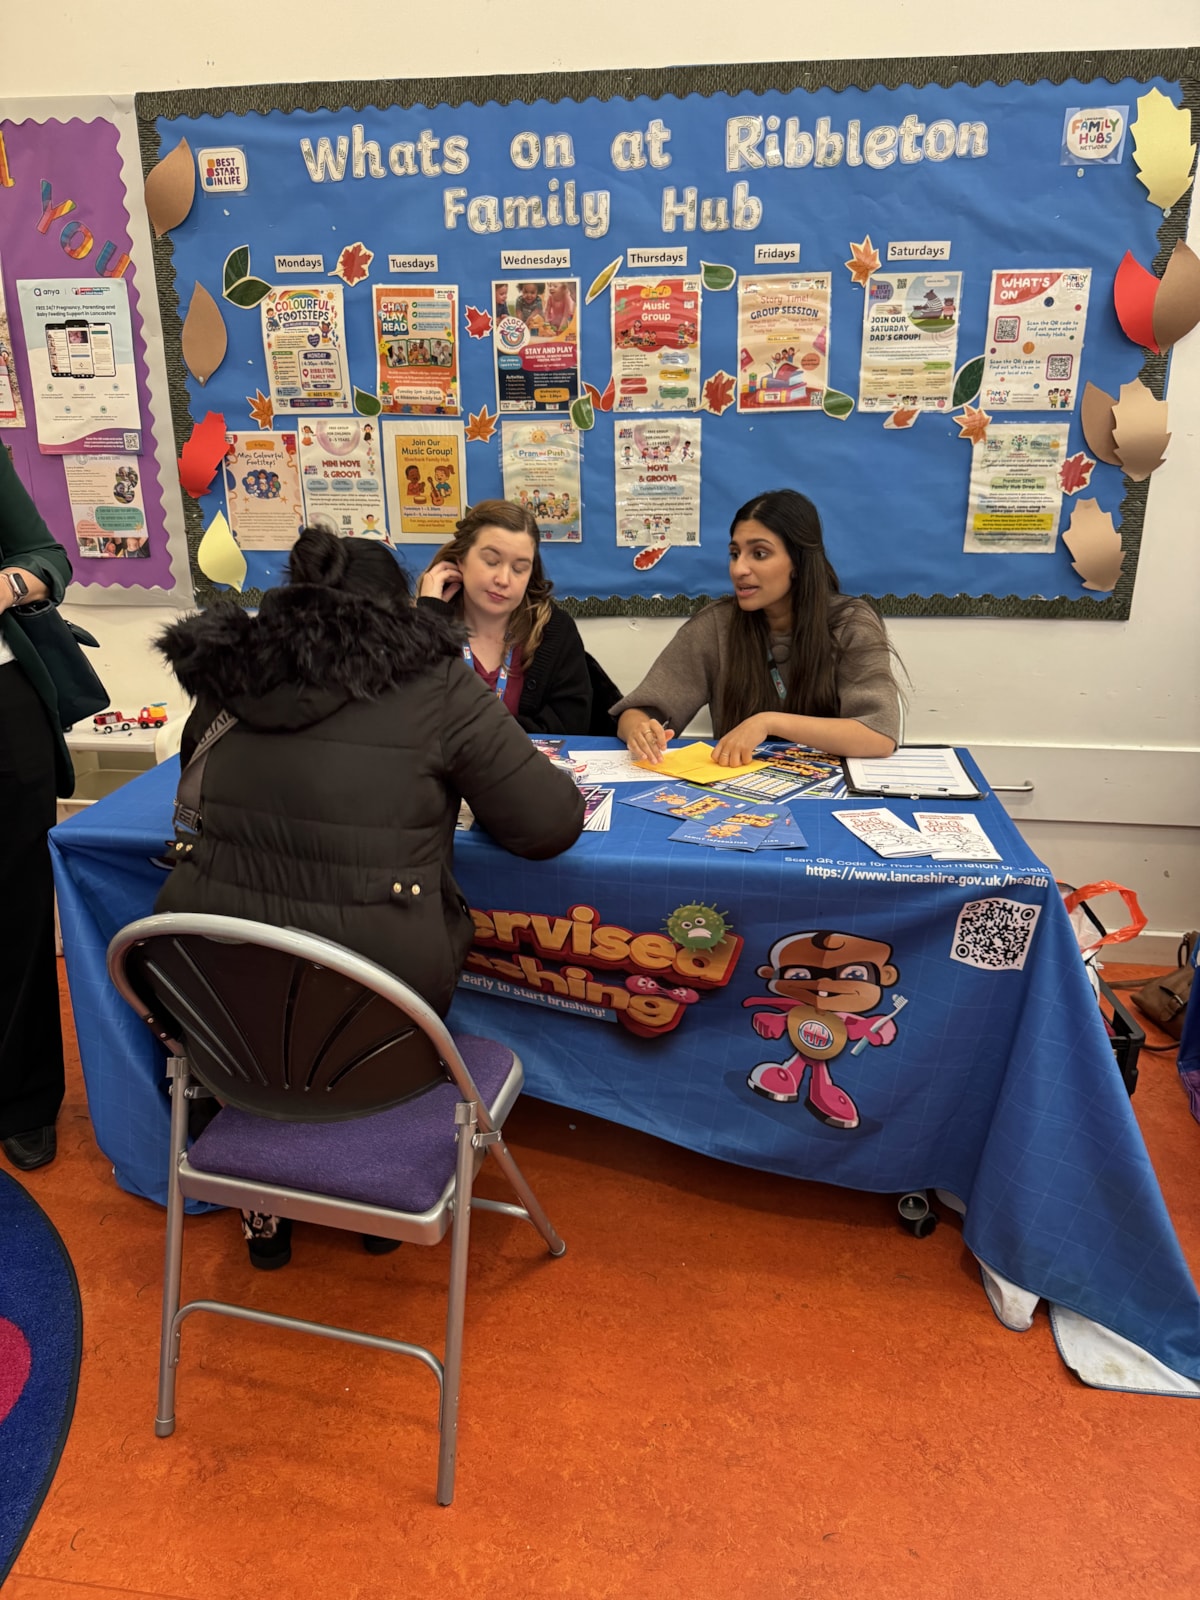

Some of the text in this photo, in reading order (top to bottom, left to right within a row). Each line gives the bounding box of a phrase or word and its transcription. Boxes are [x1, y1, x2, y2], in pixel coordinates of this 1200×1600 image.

[1071, 118, 1120, 134] FAMILY
[1079, 132, 1112, 145] HUBS
[300, 114, 988, 183] Whats on at Ribbleton
[216, 158, 235, 167] BEST
[214, 167, 240, 177] START
[214, 176, 241, 186] IN LIFE
[444, 178, 763, 238] Family Hub
[758, 248, 796, 260] Fridays
[890, 245, 945, 258] Saturdays
[391, 257, 435, 270] Tuesdays
[504, 254, 568, 267] Wednesdays
[630, 252, 684, 264] Thursdays
[278, 258, 322, 271] Mondays
[1002, 278, 1050, 288] WHAT'S
[1000, 290, 1019, 300] ON
[275, 299, 330, 313] COLOURFUL
[382, 302, 407, 312] CHAT
[642, 300, 671, 311] Music
[278, 310, 329, 323] FOOTSTEPS
[381, 312, 404, 321] PLAY
[642, 313, 671, 323] Group
[750, 306, 819, 320] GROUP SESSION
[871, 316, 889, 324] JOIN
[382, 323, 408, 332] READ
[870, 334, 892, 342] DAD'S
[557, 346, 573, 354] PLAY
[402, 448, 453, 457] Music Group!
[322, 460, 362, 468] MINI MOVE
[816, 857, 834, 865] QR
[806, 865, 1049, 888] https://www.lancashire.gov.uk/health
[462, 973, 606, 1017] early to start brushing!
